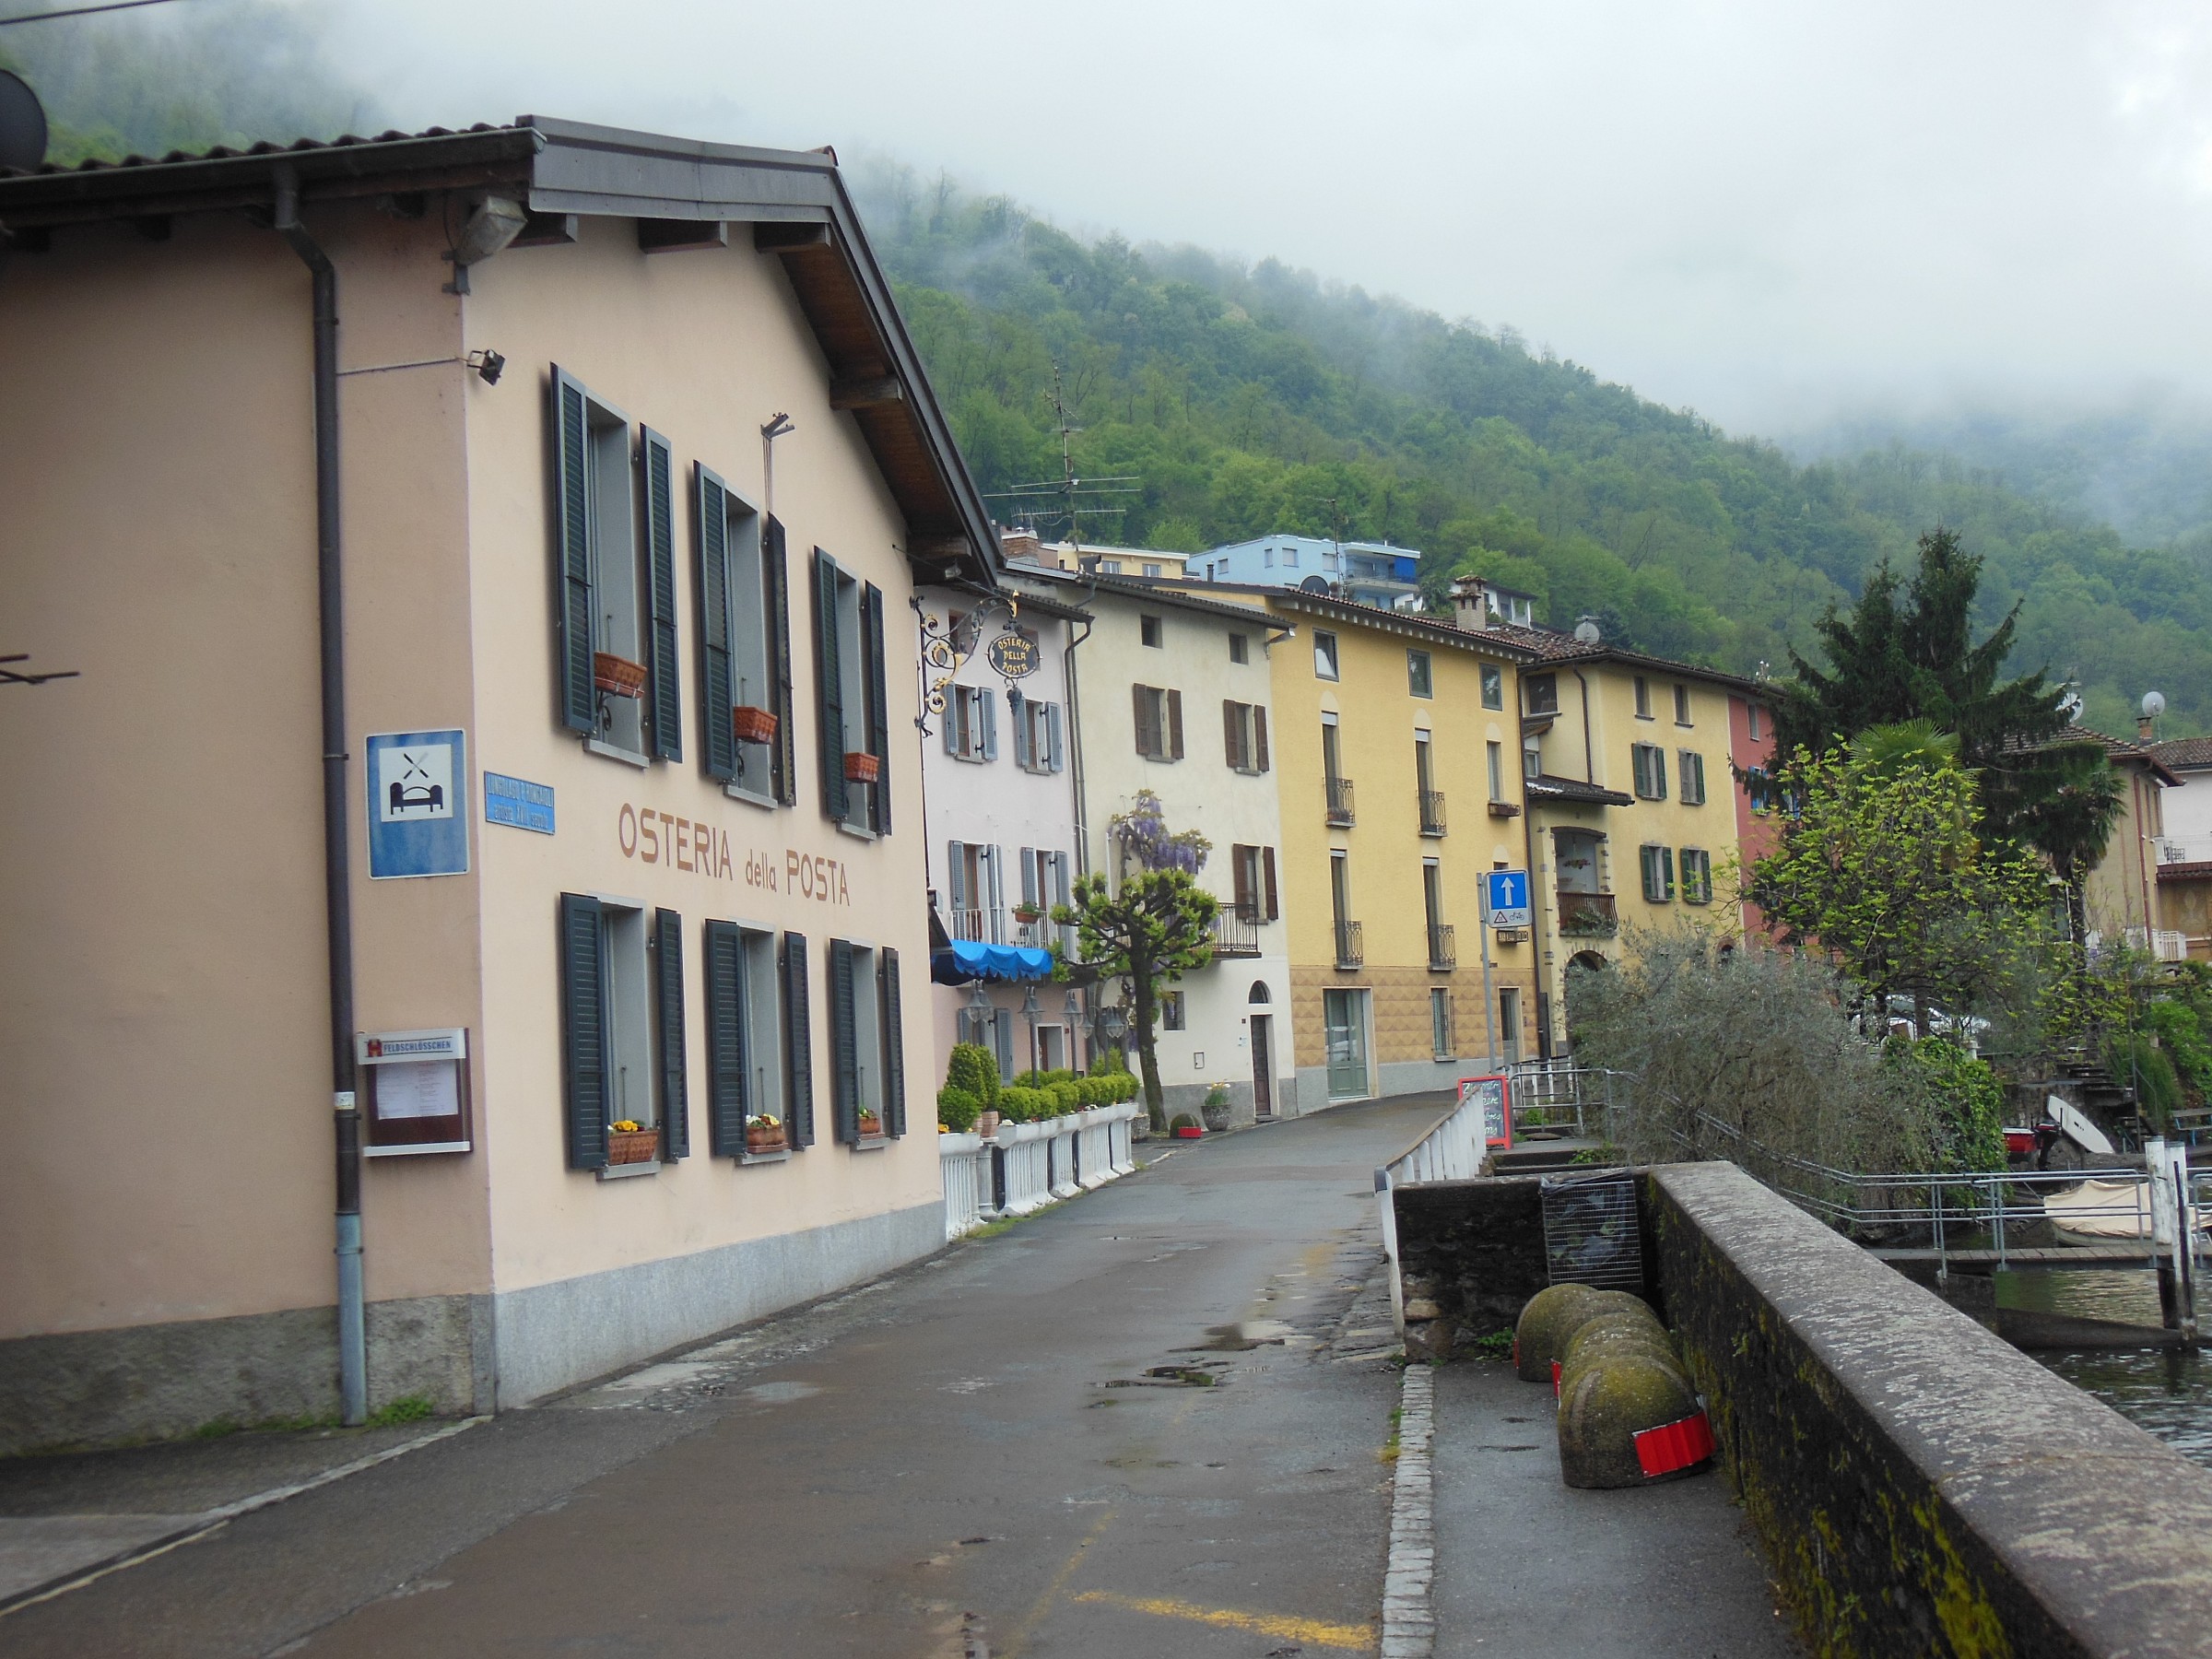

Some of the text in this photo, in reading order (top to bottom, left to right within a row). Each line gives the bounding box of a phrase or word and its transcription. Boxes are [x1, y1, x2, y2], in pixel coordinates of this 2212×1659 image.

[997, 638, 1030, 652] OSTERIA
[1004, 651, 1026, 661] DELLA
[1003, 662, 1028, 674] POSTA
[487, 775, 519, 800] LUNGOLAGO
[618, 803, 850, 907] OSTERIA della POSTA
[383, 1040, 451, 1053] FELDSCHLÖSSCHEN
